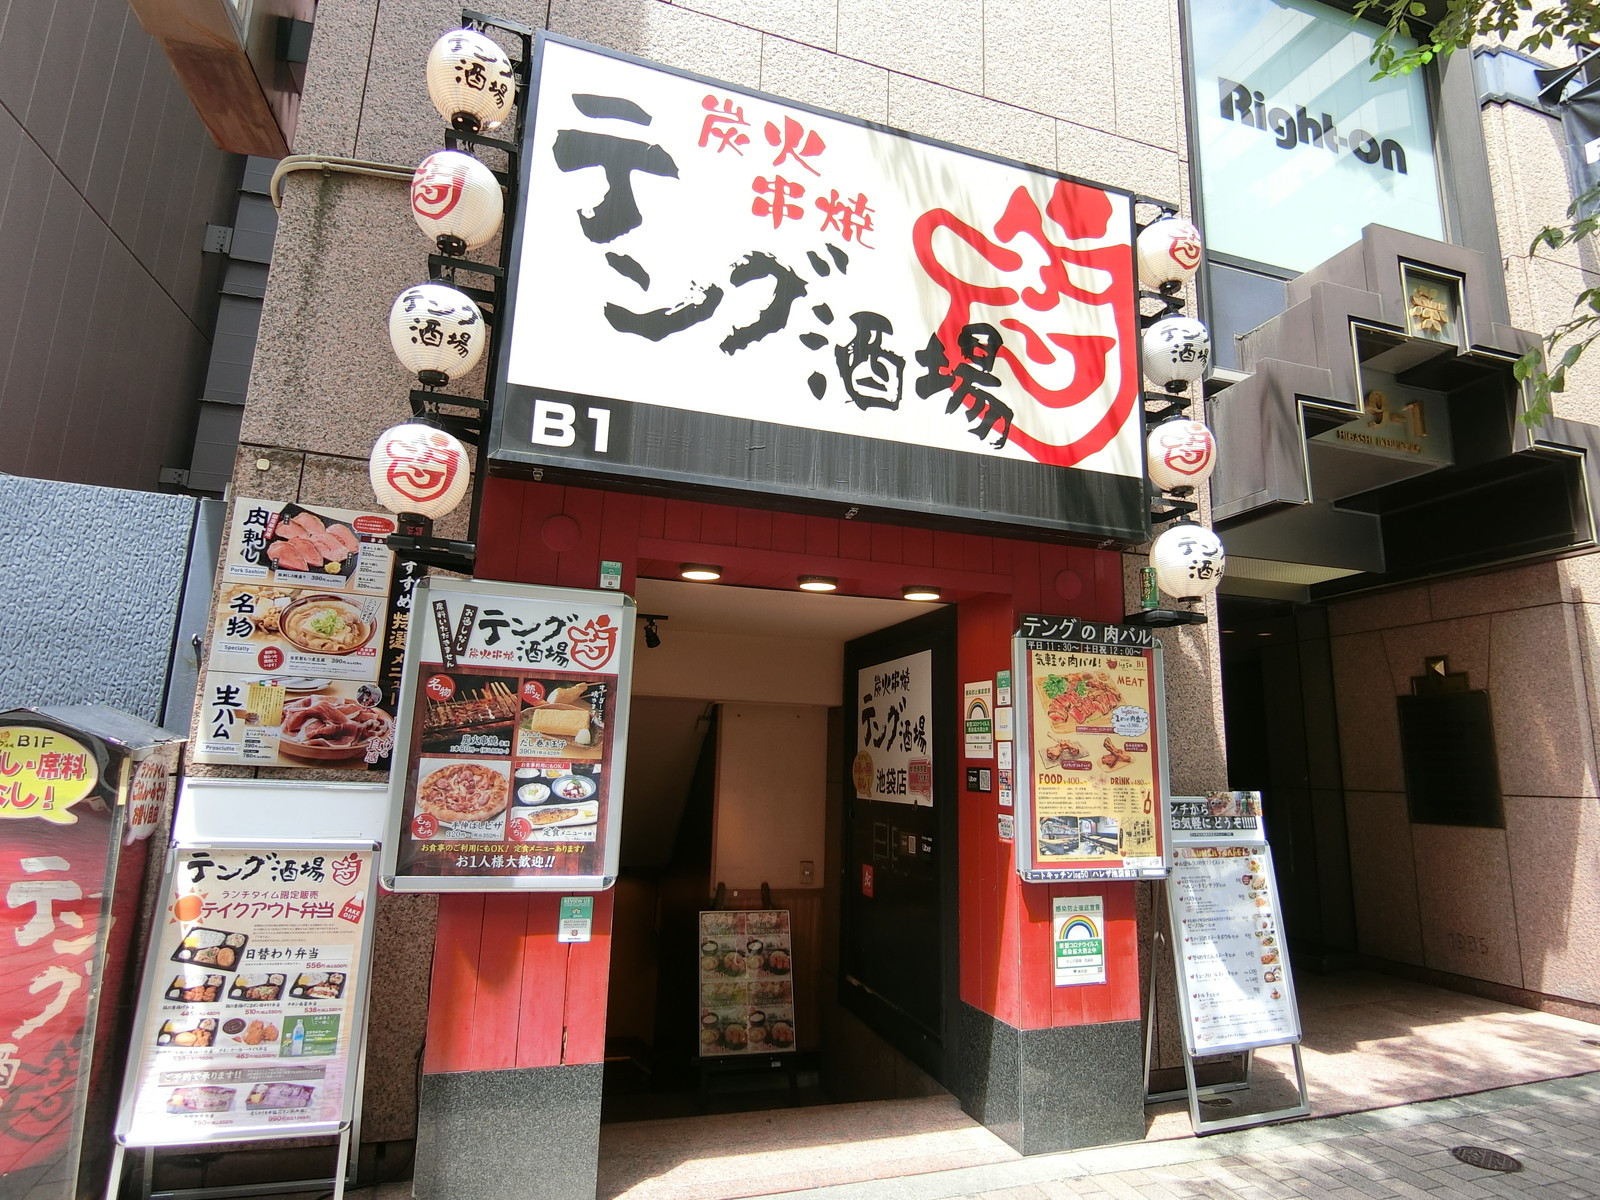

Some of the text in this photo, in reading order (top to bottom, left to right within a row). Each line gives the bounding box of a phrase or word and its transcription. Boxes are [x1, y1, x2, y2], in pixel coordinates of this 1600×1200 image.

[455, 59, 508, 109] 酒場
[698, 94, 827, 177] 炭火
[751, 174, 876, 250] 串焼
[409, 318, 472, 359] 酒場
[1170, 342, 1209, 368] 酒場
[530, 398, 614, 453] B1
[240, 506, 270, 564] 肉刺し
[230, 566, 267, 576] Pork Sashimi
[226, 593, 256, 638] 名物
[478, 607, 580, 646] テング
[1103, 624, 1152, 645] 肉バル
[224, 645, 250, 653] Specialty
[468, 647, 515, 662] 炭火串焼
[516, 639, 571, 669] 酒場
[1027, 640, 1043, 650] 平日
[1083, 645, 1108, 655] 土日祝
[427, 677, 452, 698] 名物
[523, 683, 541, 699] 熱々
[874, 667, 911, 698] 炭火串焼
[1117, 675, 1145, 688] MEAT
[212, 684, 243, 740] 生ハム
[861, 693, 927, 755] テング酒場
[18, 735, 54, 748] B1F
[460, 733, 499, 747] 炭火串焼
[0, 753, 87, 780] し・席料
[875, 767, 907, 796] 池袋店
[1038, 773, 1063, 785] FOOD
[451, 821, 504, 831] 手伸ばしピザ
[421, 843, 586, 854] お食事のご利用にもOK! 定食メニューあります!
[187, 851, 326, 884] テング酒場
[455, 855, 556, 869] お1人様大歓迎!!
[221, 891, 320, 900] ランチタイム限定販売
[202, 901, 335, 920] テイクアウト弁当
[342, 911, 358, 921] OUT
[343, 905, 361, 916] TAKE
[245, 948, 320, 960] 日替わり弁当
